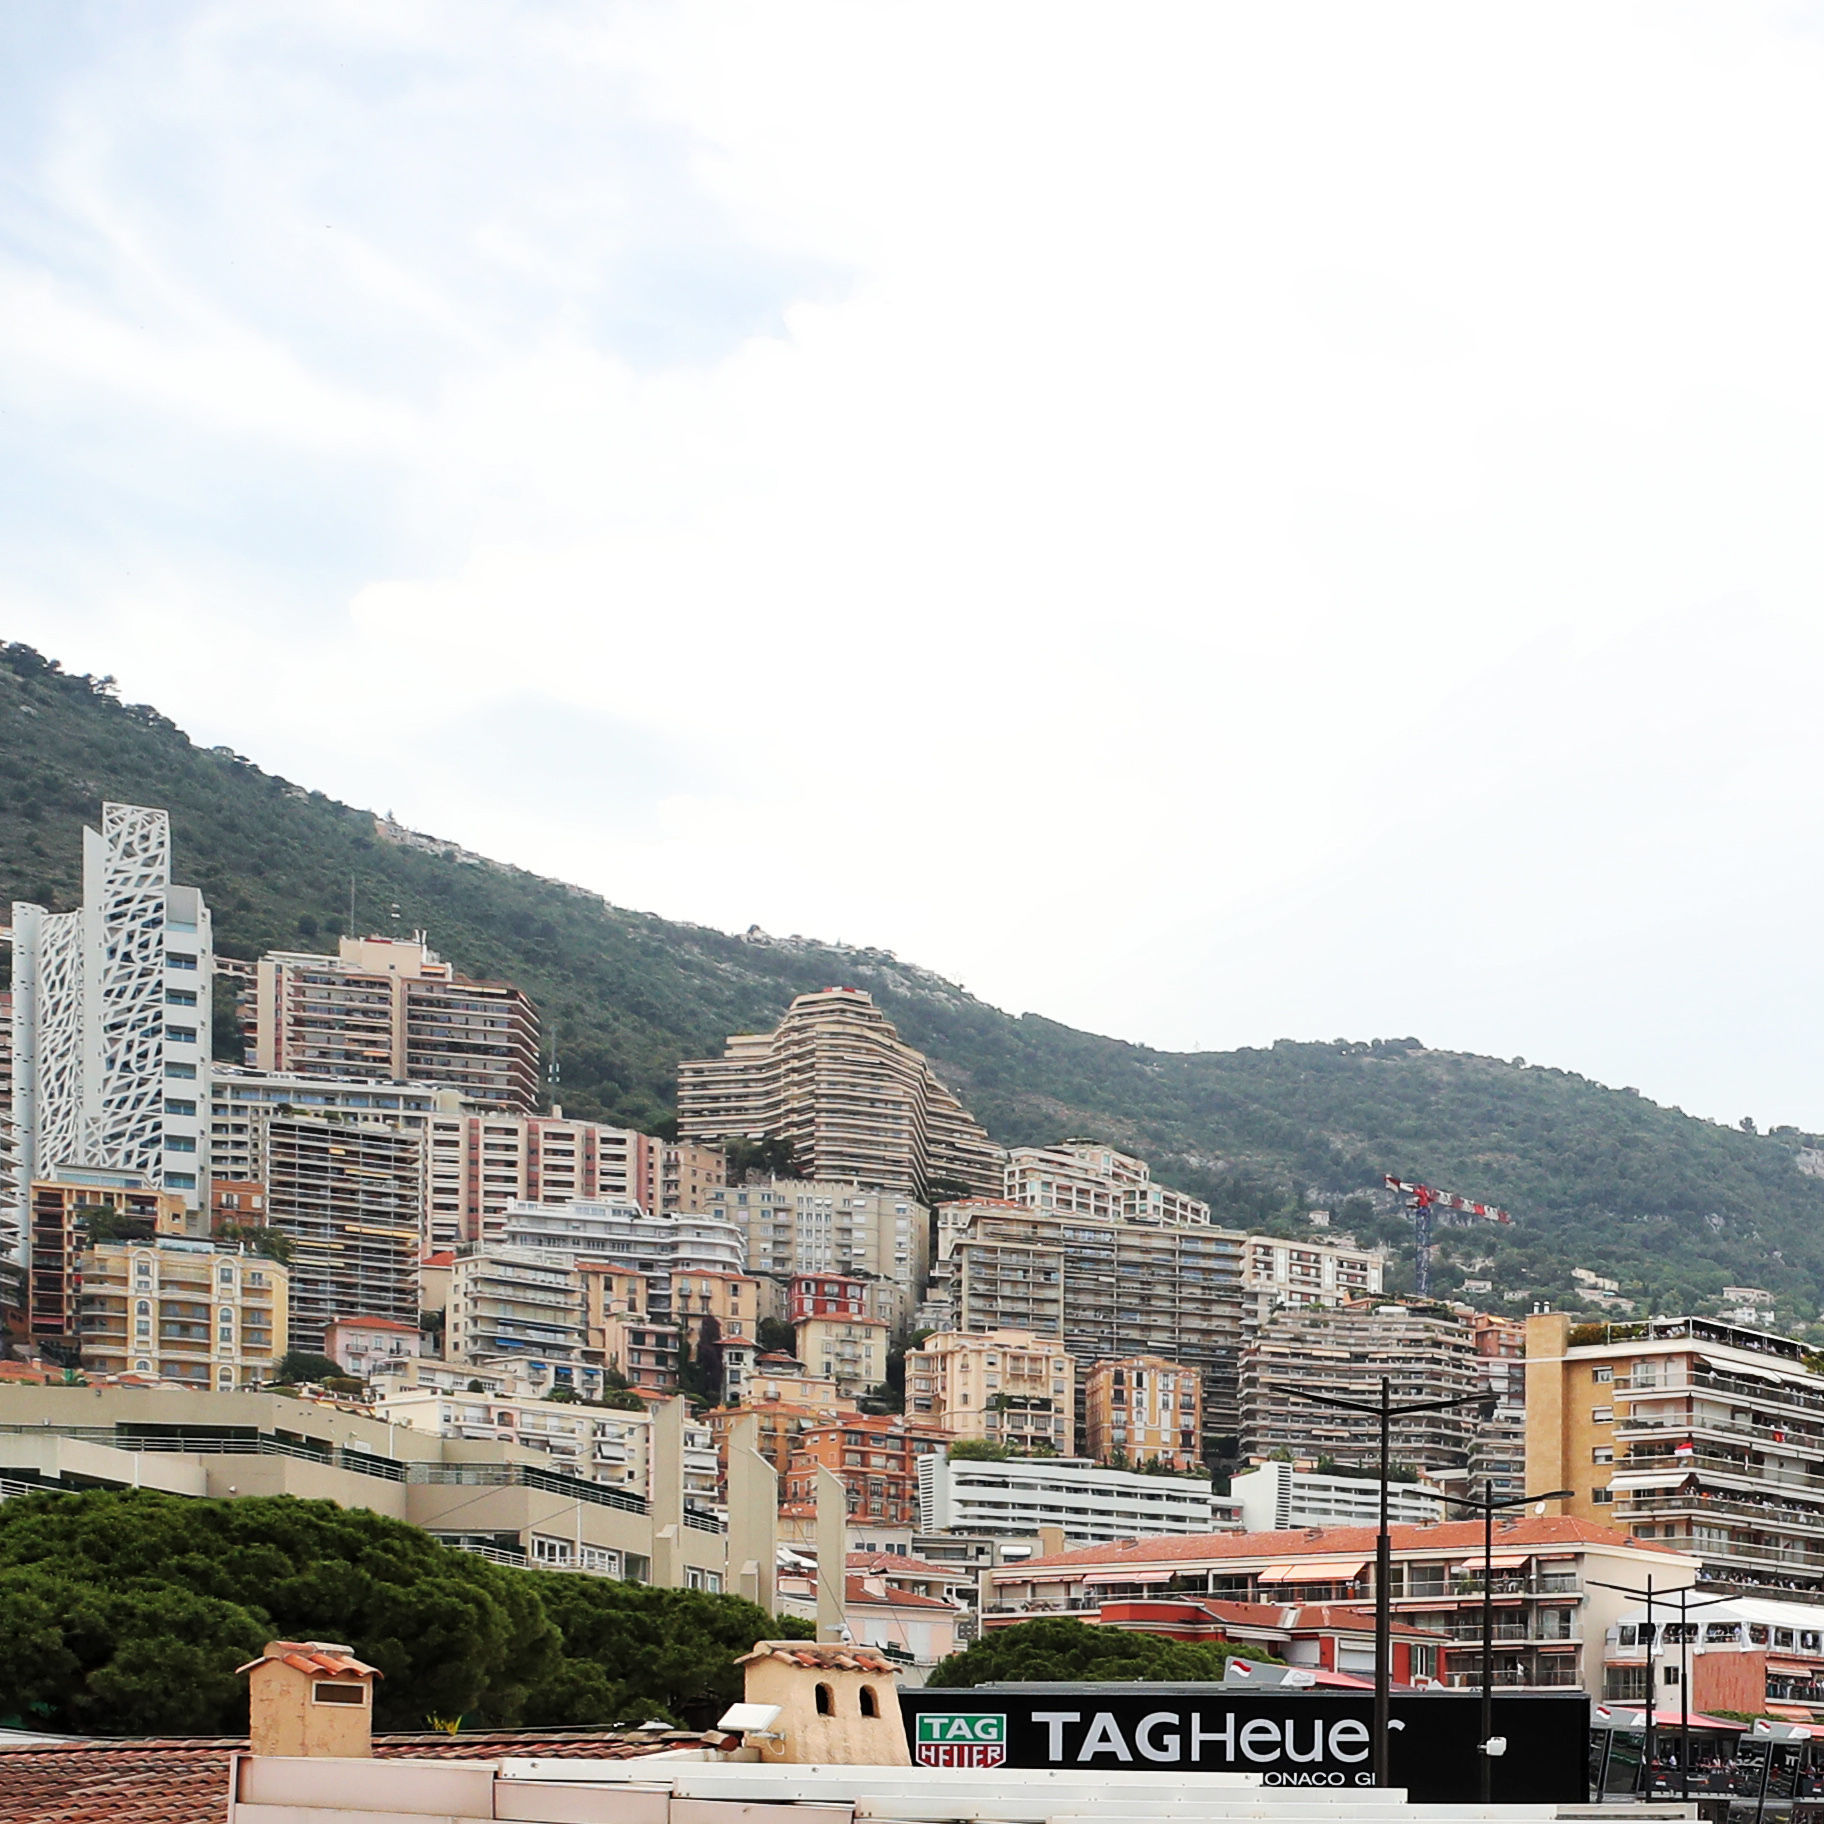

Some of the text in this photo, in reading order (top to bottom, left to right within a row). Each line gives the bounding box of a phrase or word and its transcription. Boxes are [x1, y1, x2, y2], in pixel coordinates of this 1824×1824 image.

[924, 1717, 998, 1740] TAG
[1262, 1772, 1376, 1786] ONACO G
